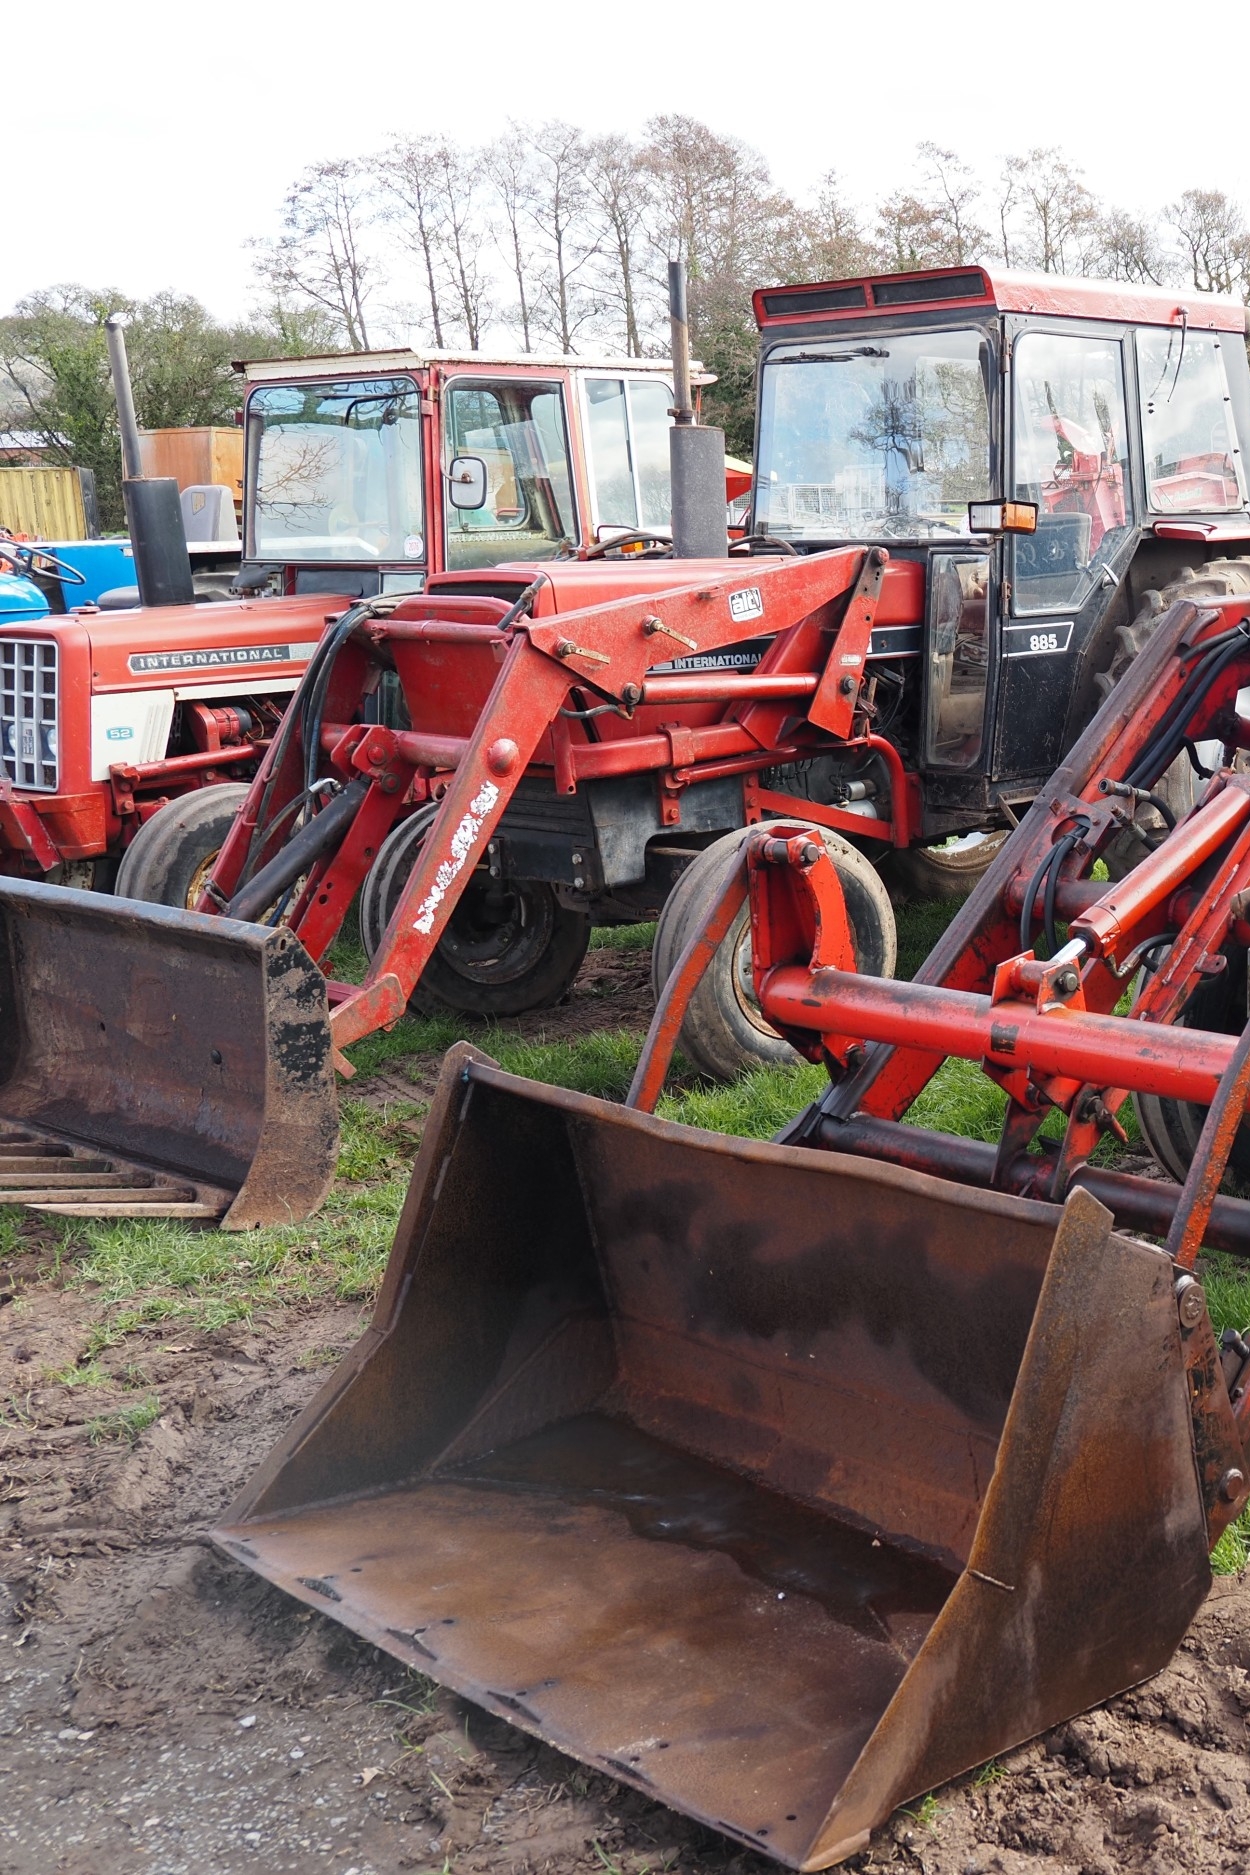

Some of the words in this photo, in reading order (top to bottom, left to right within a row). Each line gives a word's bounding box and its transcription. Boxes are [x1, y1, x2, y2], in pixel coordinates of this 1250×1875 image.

[1030, 633, 1058, 651] 885
[139, 648, 283, 669] INTERNATIONAL
[110, 729, 131, 739] 52
